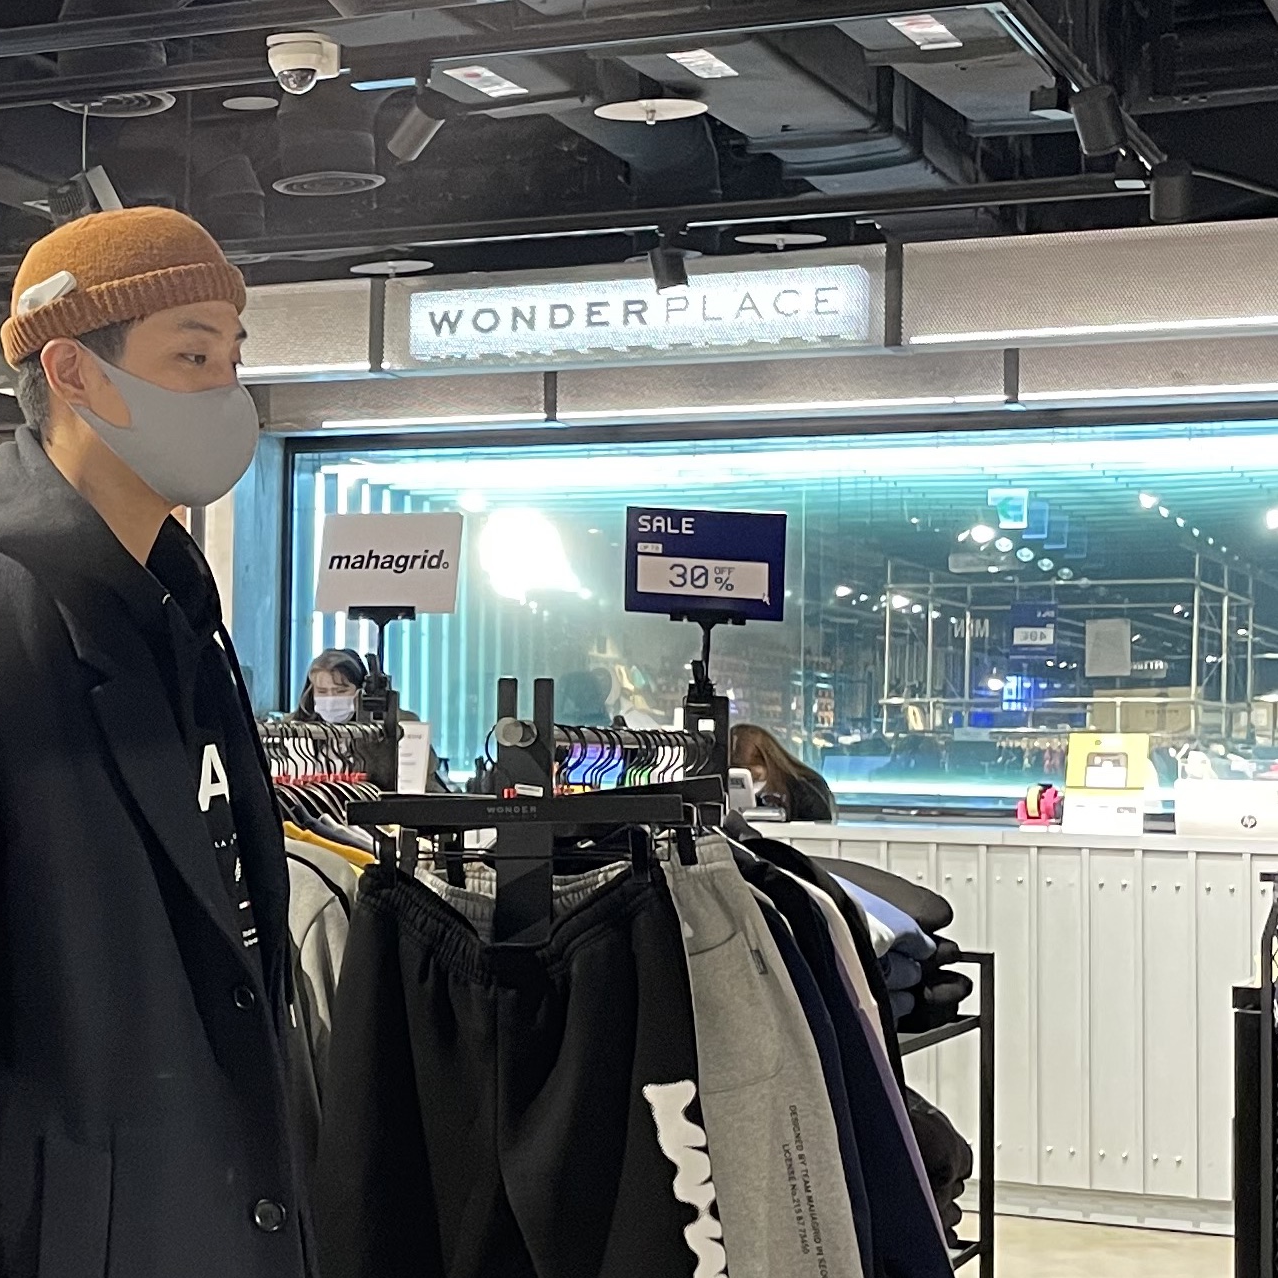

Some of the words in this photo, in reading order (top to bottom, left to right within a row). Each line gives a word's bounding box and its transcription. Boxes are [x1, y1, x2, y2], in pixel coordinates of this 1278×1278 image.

[429, 286, 839, 337] WONDERPLACE
[638, 515, 695, 535] SALE
[714, 566, 736, 576] OFF
[486, 805, 537, 814] WONDER
[800, 1168, 812, 1194] TEAM
